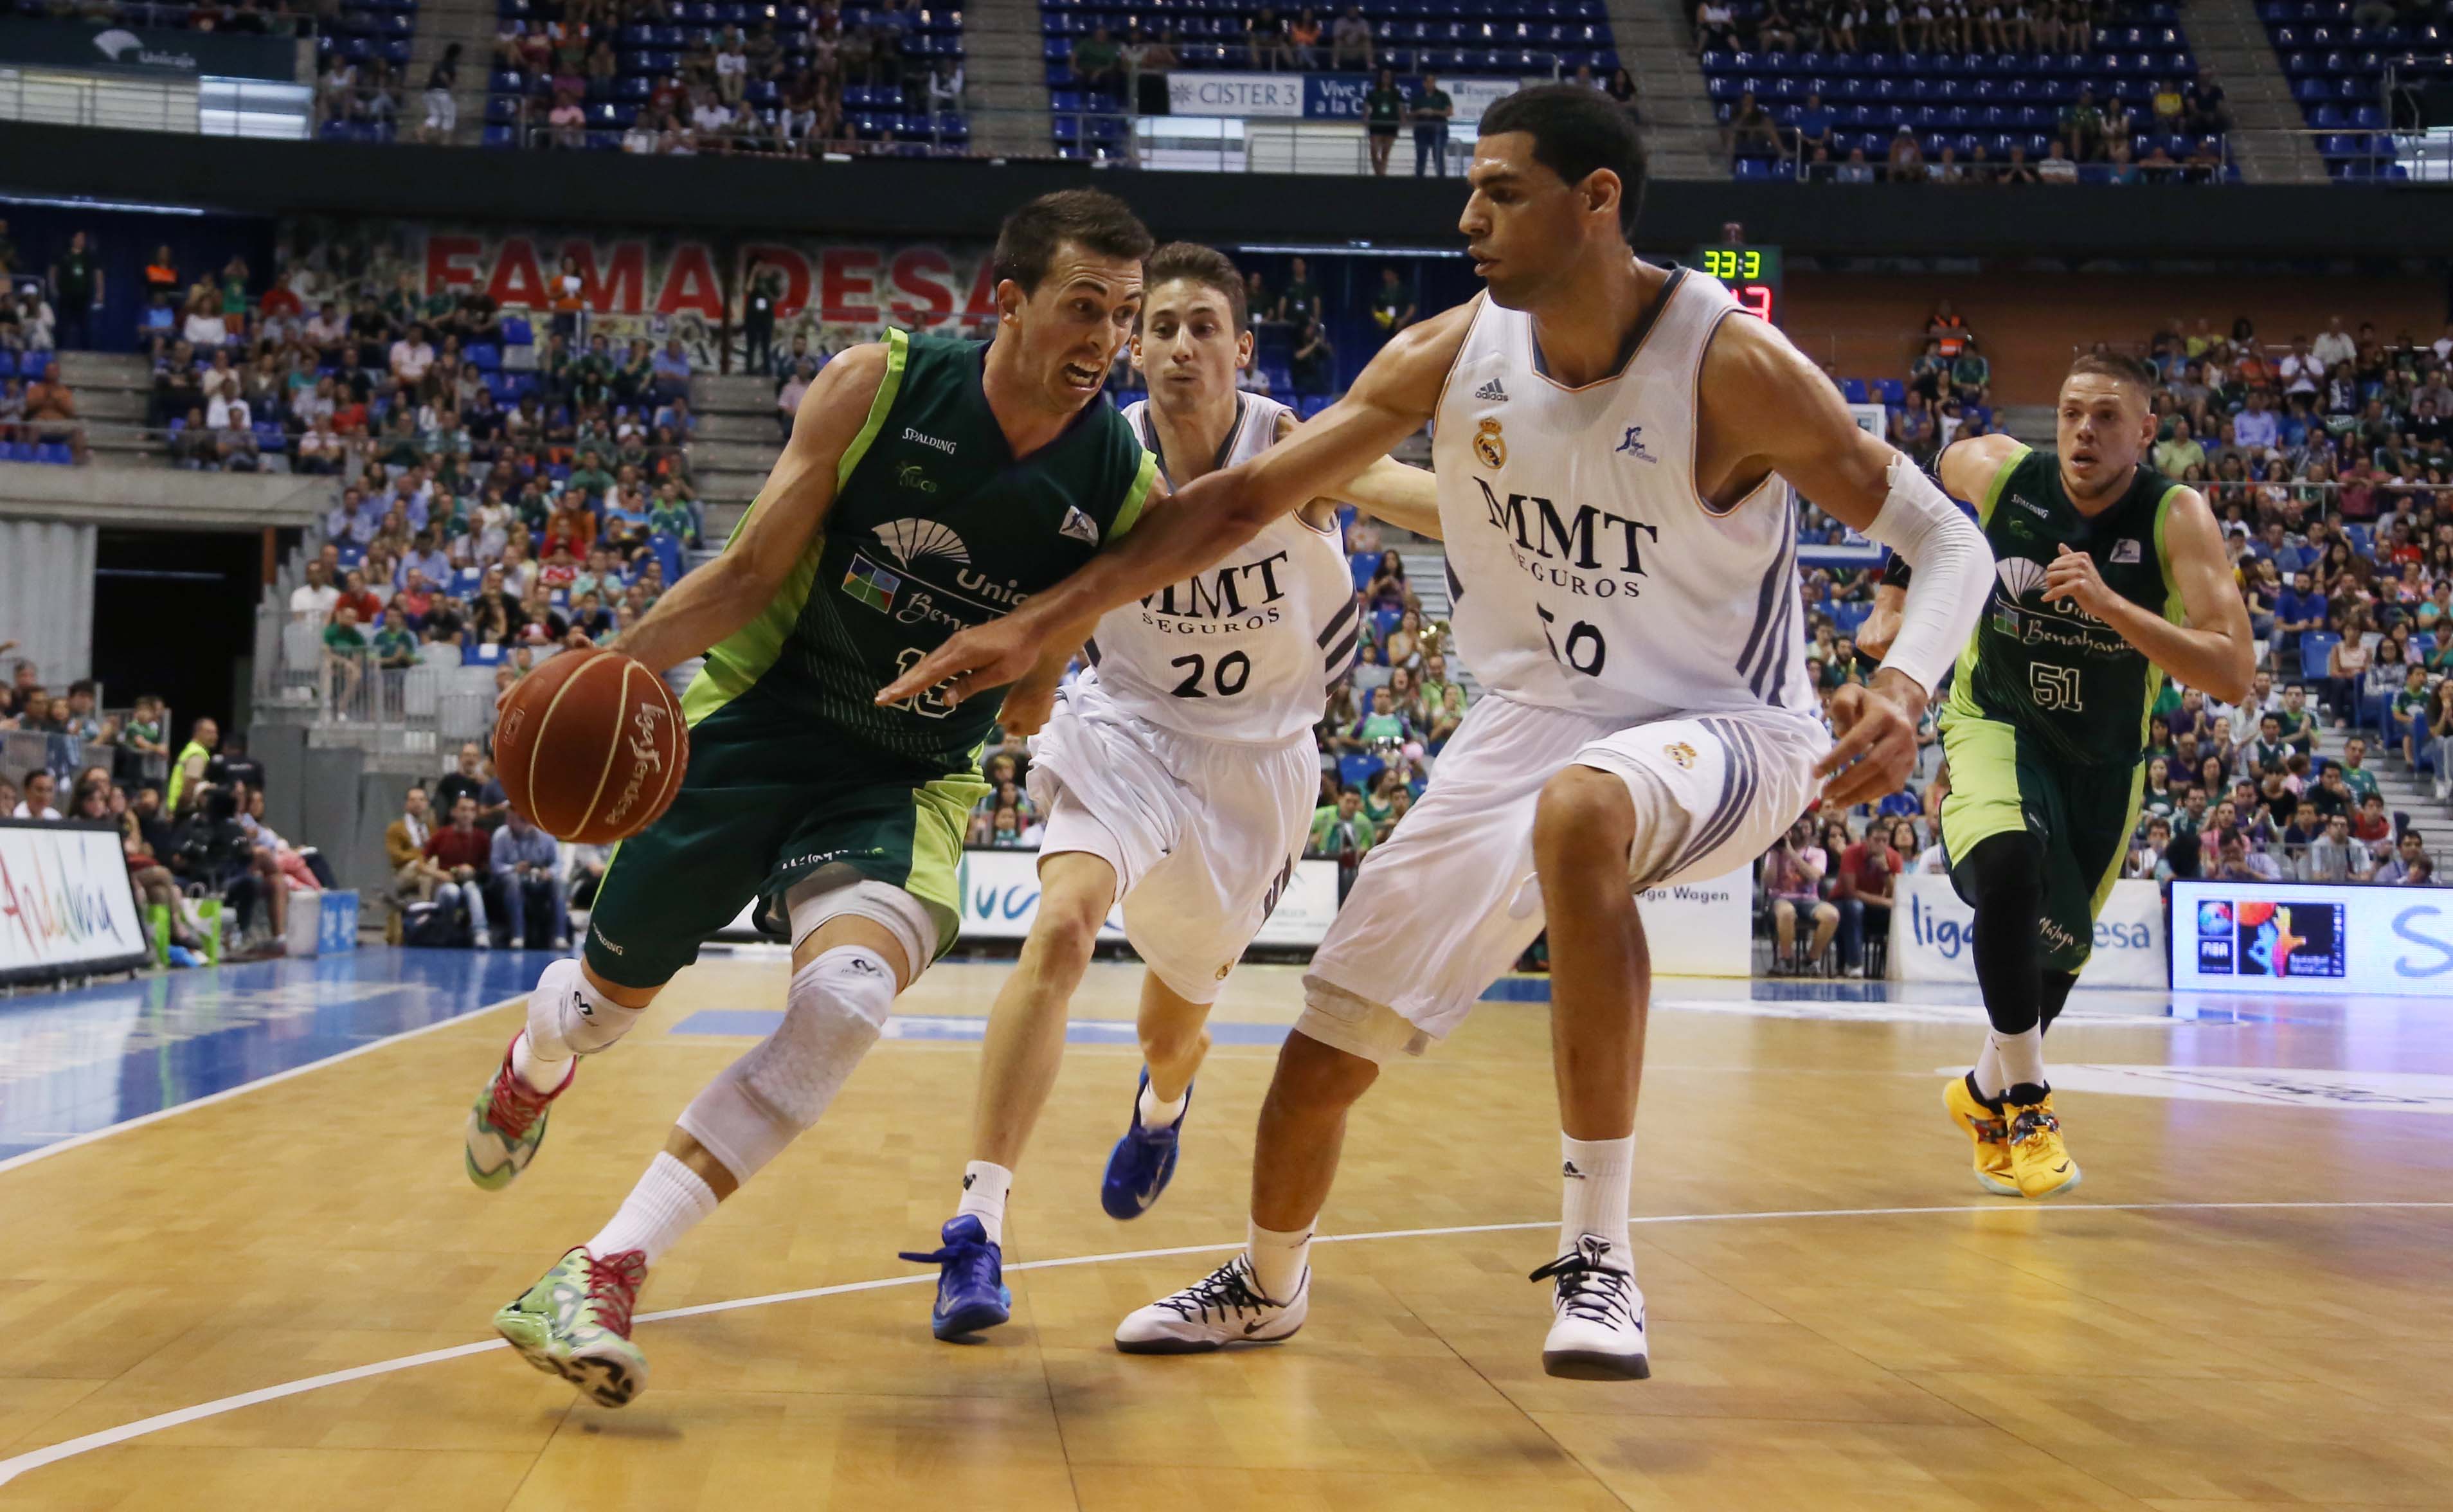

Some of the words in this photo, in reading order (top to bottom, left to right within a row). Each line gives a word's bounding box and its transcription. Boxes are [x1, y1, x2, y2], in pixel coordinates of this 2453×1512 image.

[1200, 82, 1279, 105] CISTER
[1282, 84, 1297, 105] 3
[1475, 391, 1509, 402] adidas
[902, 428, 957, 455] SPALDING
[2011, 494, 2049, 519] SPALDING
[1472, 476, 1658, 577] MMT
[956, 568, 1029, 606] Unic
[1142, 606, 1280, 634] SEGUROS
[1171, 650, 1251, 698] 20
[2029, 661, 2083, 712] 51
[1673, 885, 1729, 905] Wagen
